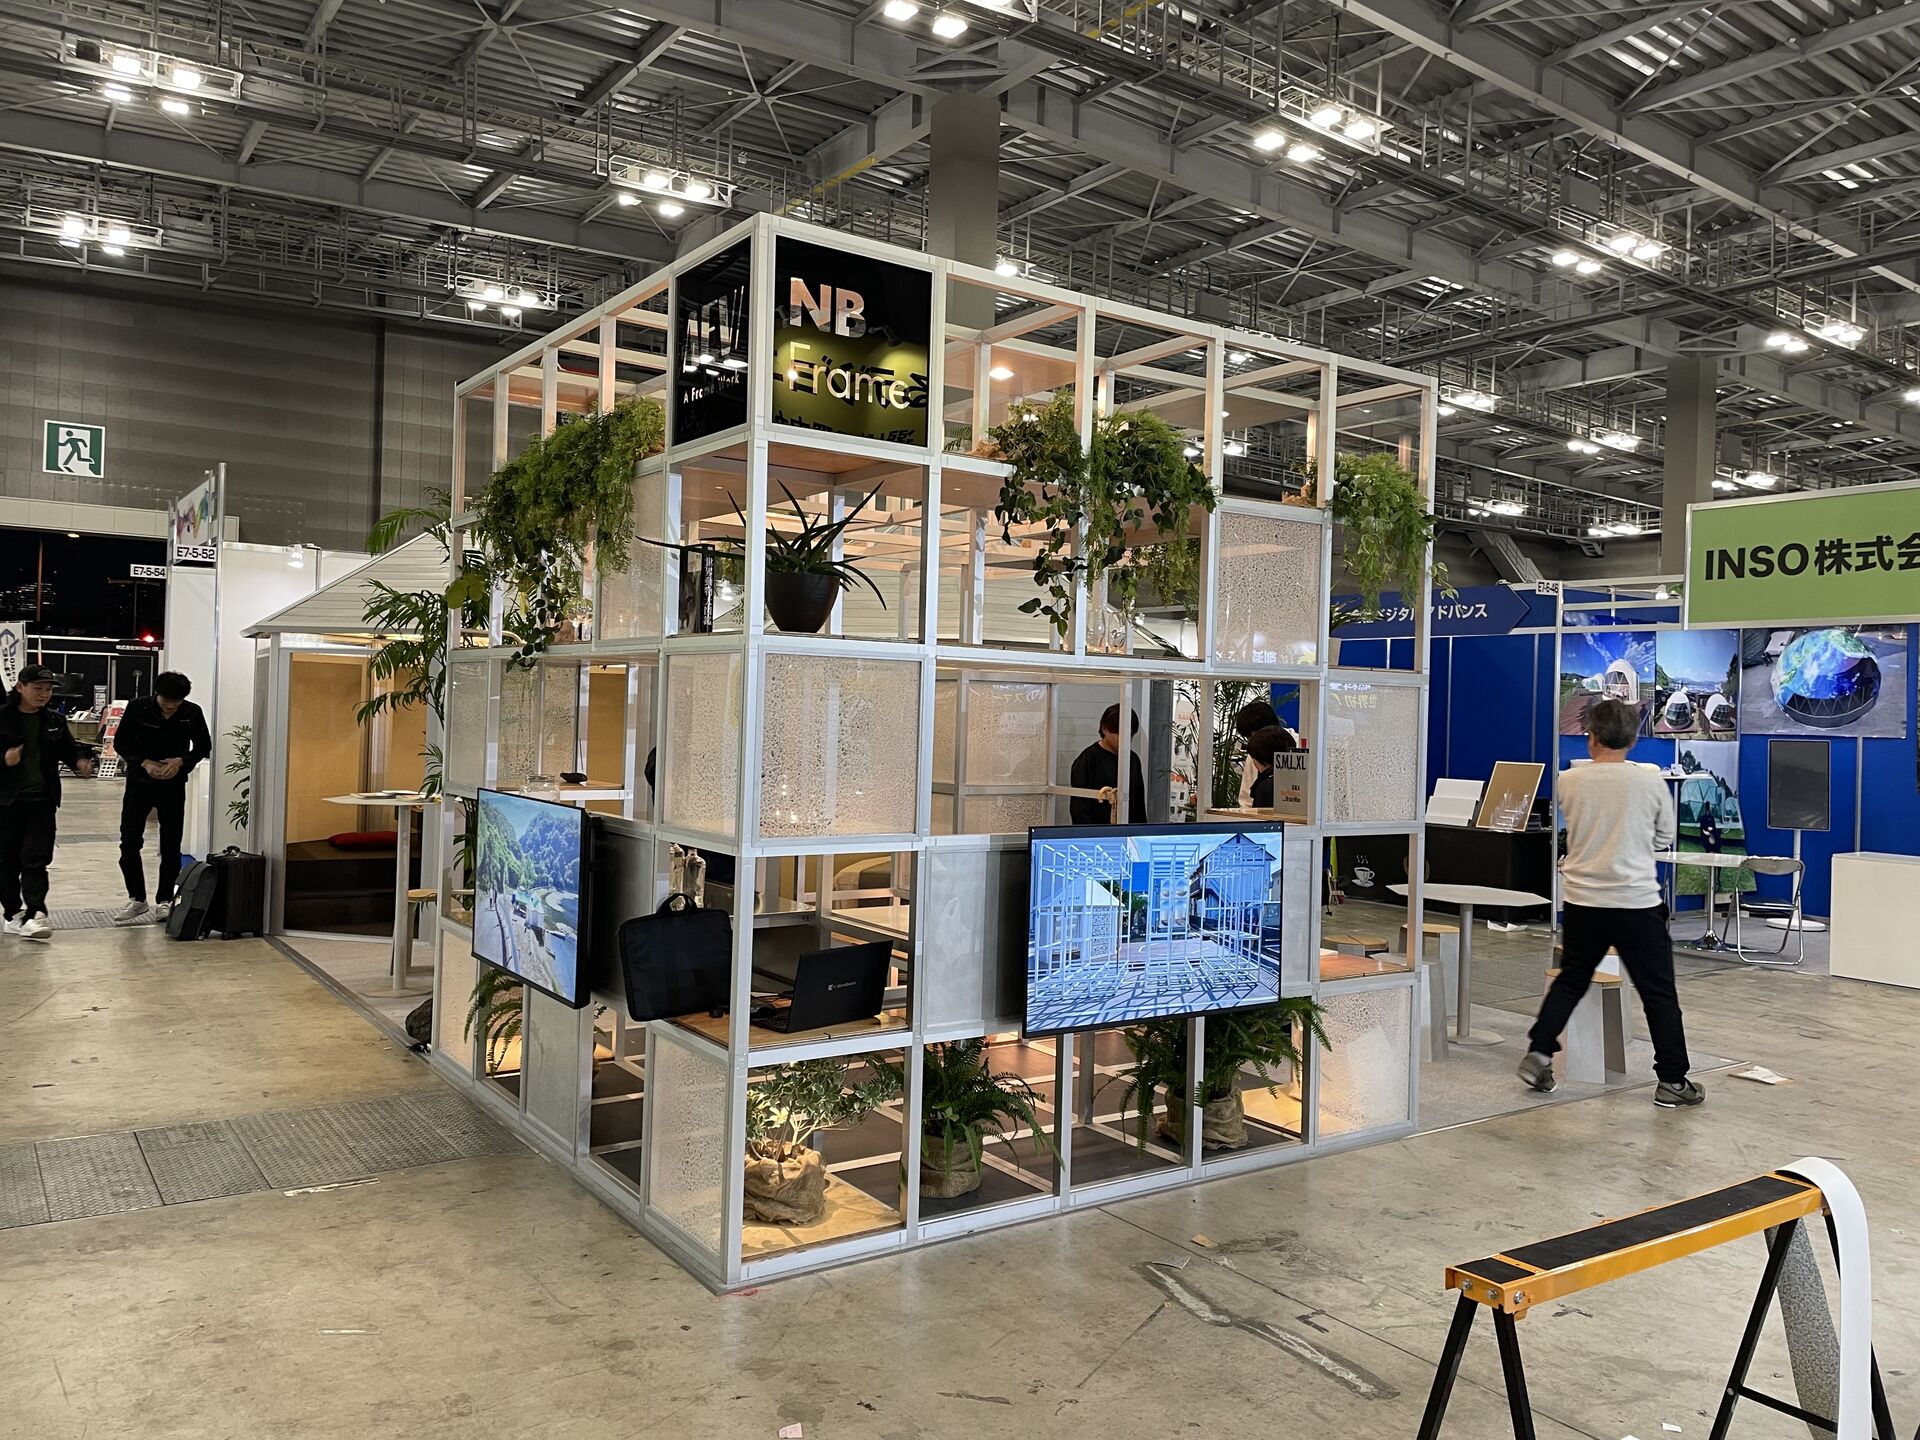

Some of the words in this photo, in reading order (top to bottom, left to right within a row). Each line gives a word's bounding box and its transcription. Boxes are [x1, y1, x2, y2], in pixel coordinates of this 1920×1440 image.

[789, 277, 867, 339] NB
[788, 341, 911, 410] Frame
[133, 566, 165, 577] E7-5-54
[176, 546, 215, 560] E7-5-52
[1705, 533, 1920, 581] INSO株式会
